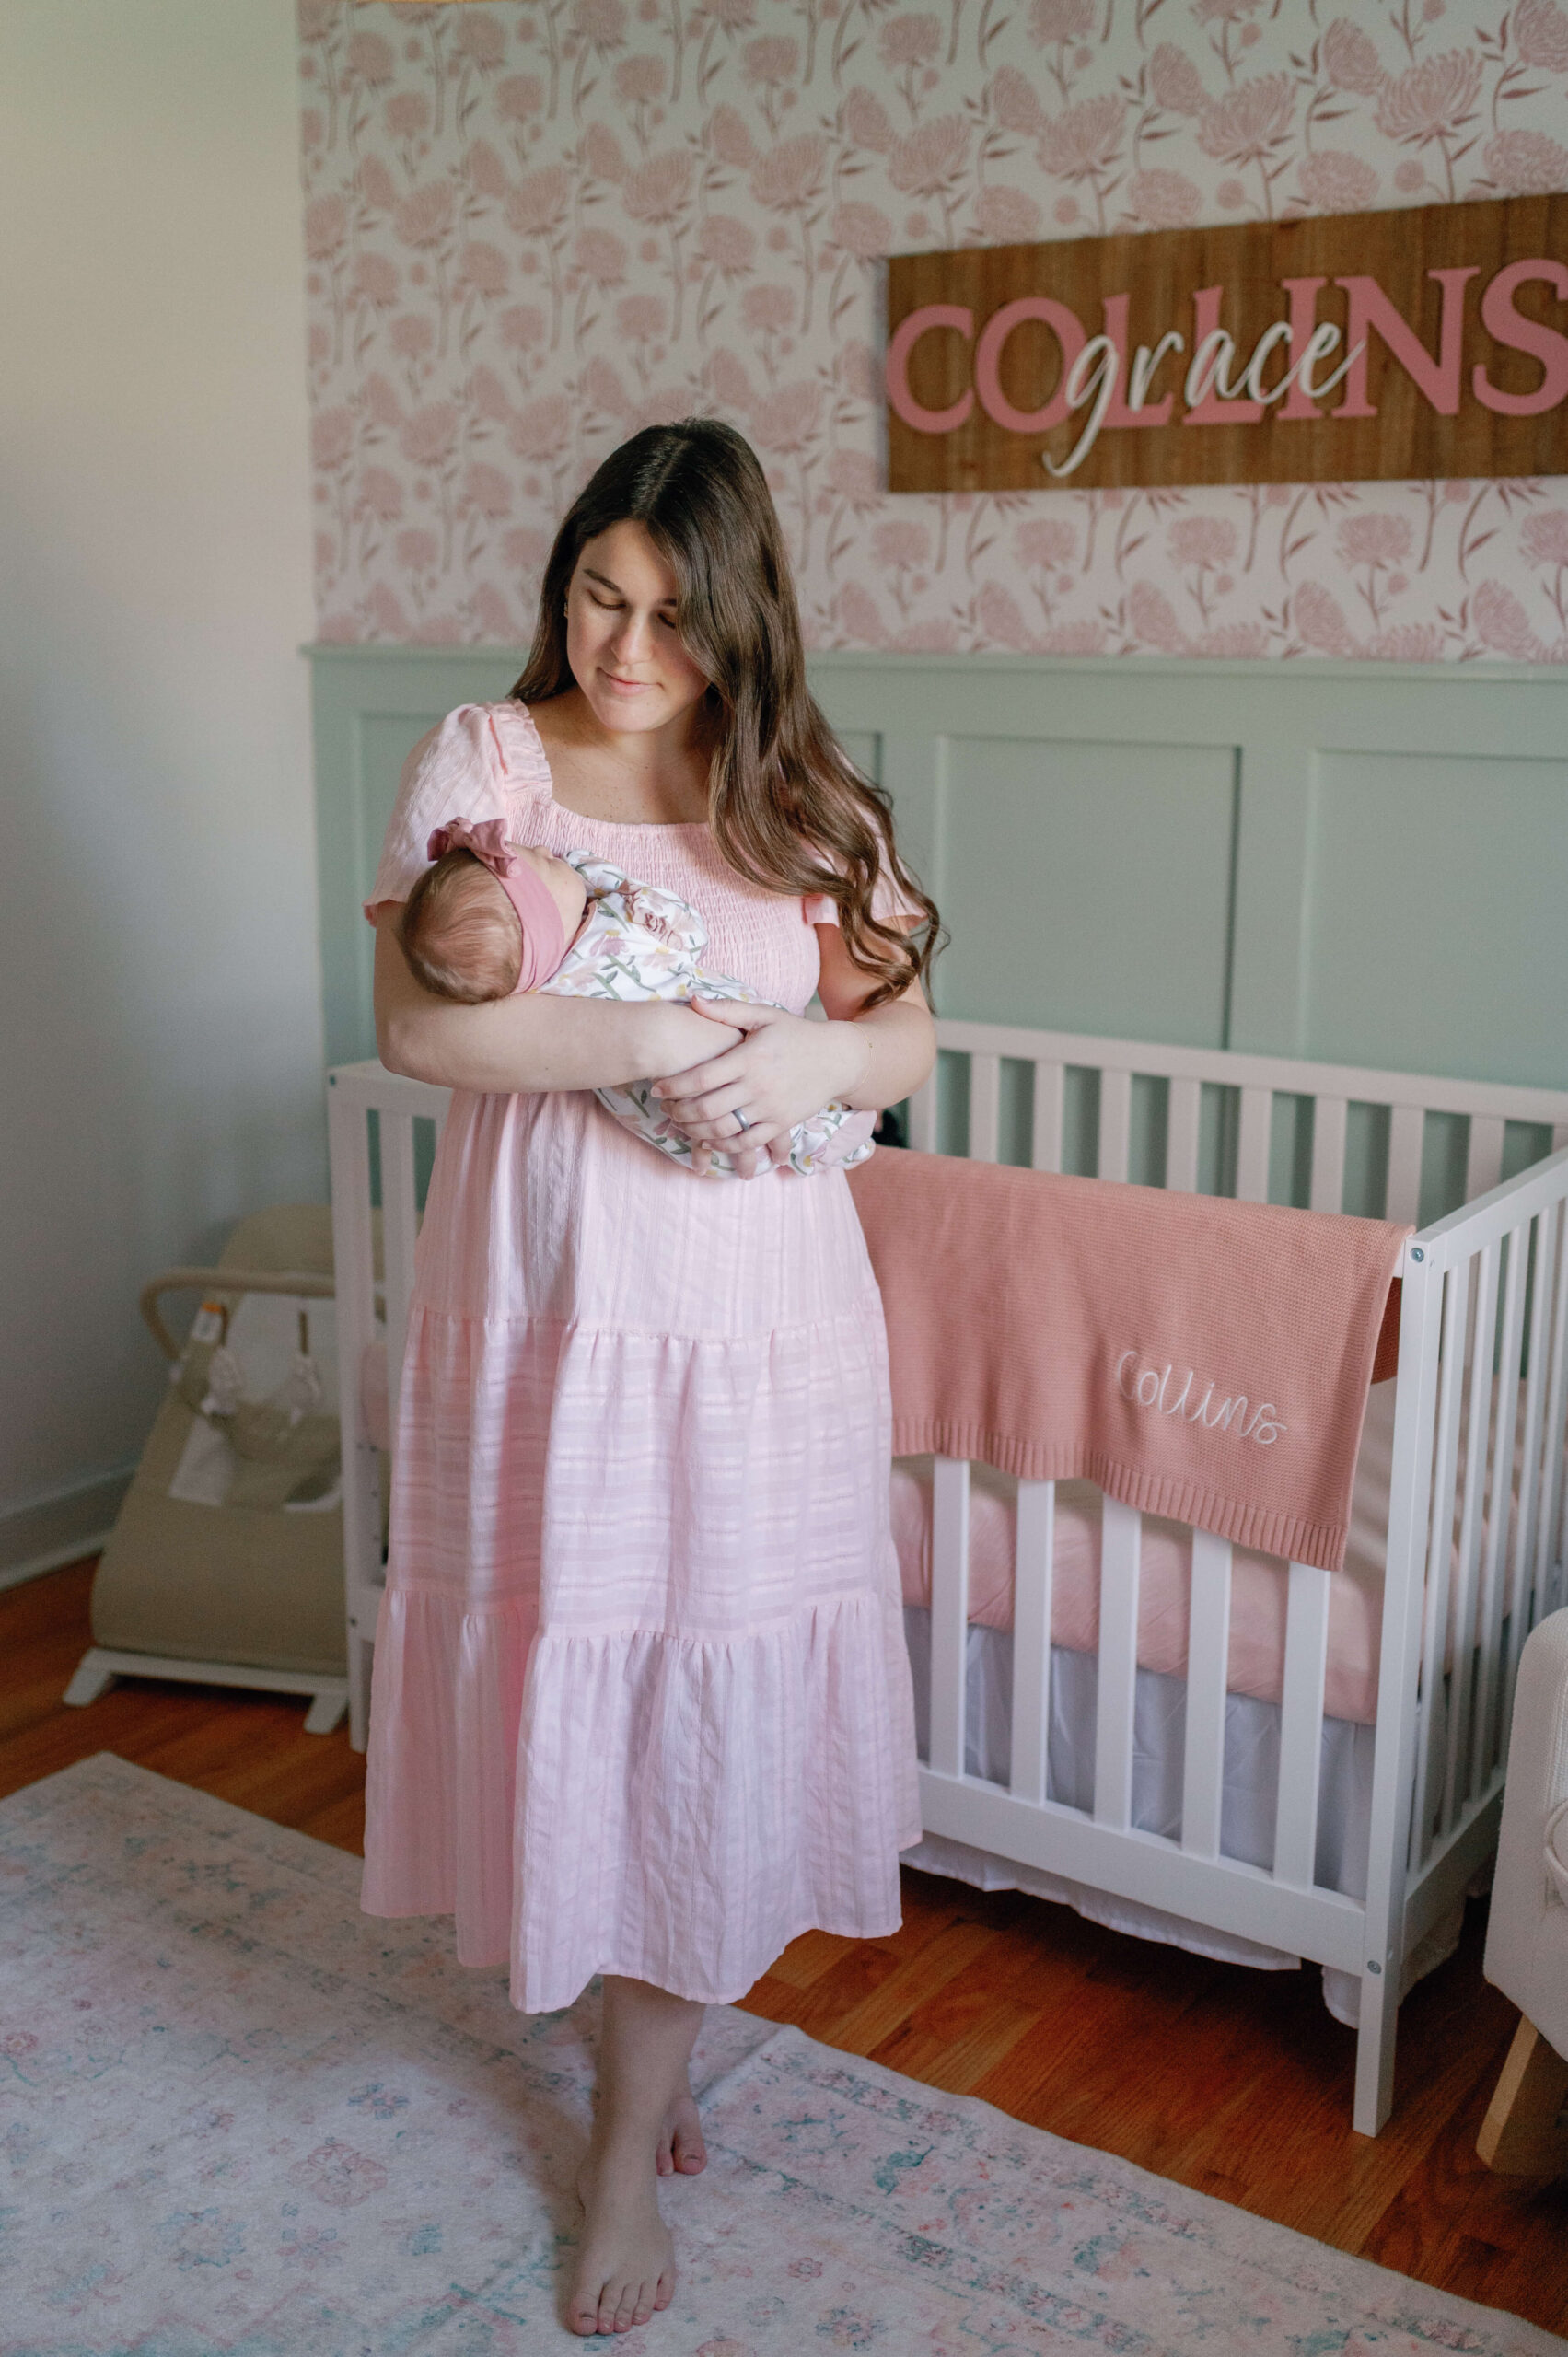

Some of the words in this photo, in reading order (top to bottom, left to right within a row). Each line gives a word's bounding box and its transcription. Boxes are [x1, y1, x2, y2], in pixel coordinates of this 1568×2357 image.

[887, 258, 1568, 434] COLLINS
[1042, 320, 1366, 477] grace
[1117, 1351, 1287, 1444] Collins
